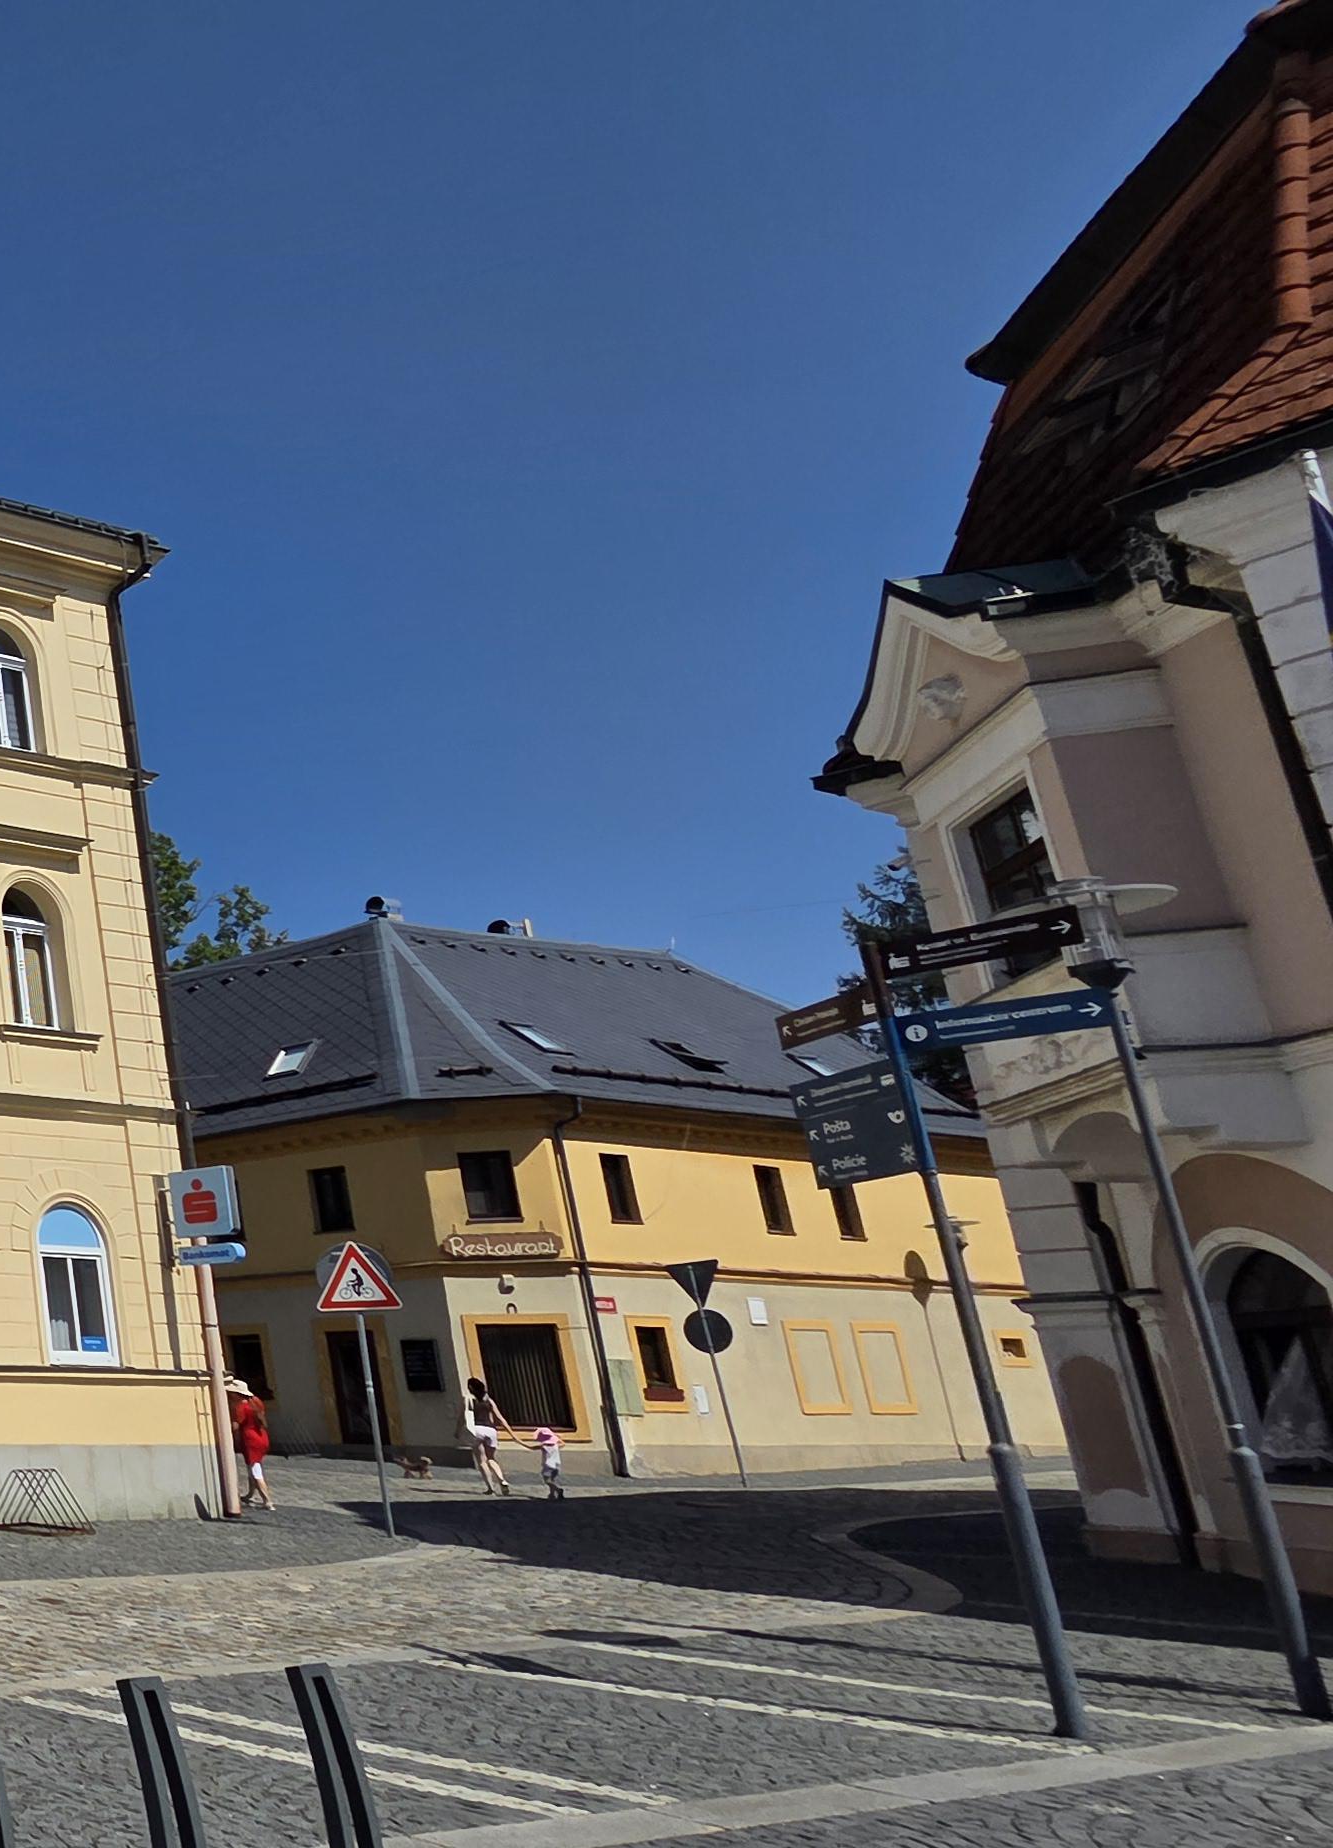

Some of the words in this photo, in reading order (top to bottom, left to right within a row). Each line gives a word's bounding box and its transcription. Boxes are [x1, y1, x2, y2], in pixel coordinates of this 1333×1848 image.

[822, 1120, 851, 1135] Pošta
[832, 1154, 867, 1170] Policie
[449, 1236, 558, 1257] Restaurant
[182, 1249, 230, 1260] Bankomat
